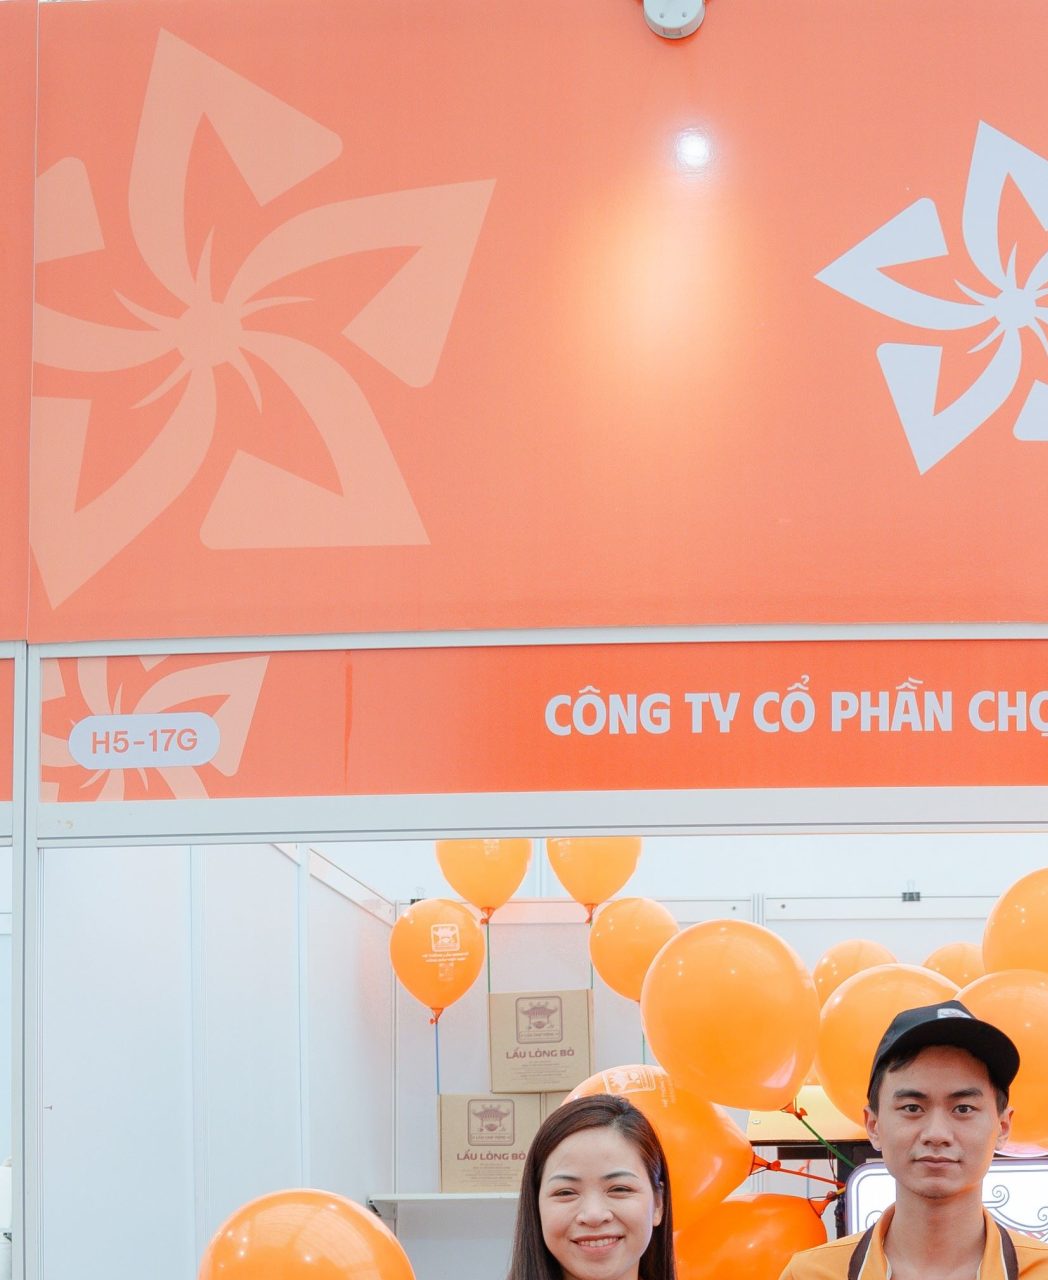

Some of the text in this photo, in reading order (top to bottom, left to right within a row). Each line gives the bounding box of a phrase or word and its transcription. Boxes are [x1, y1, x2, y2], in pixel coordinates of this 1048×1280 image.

[544, 685, 671, 736] CÔNG
[685, 692, 737, 734] TY
[753, 675, 815, 733] CỔ
[832, 677, 953, 732] PHẦN
[92, 728, 198, 754] H5-17G
